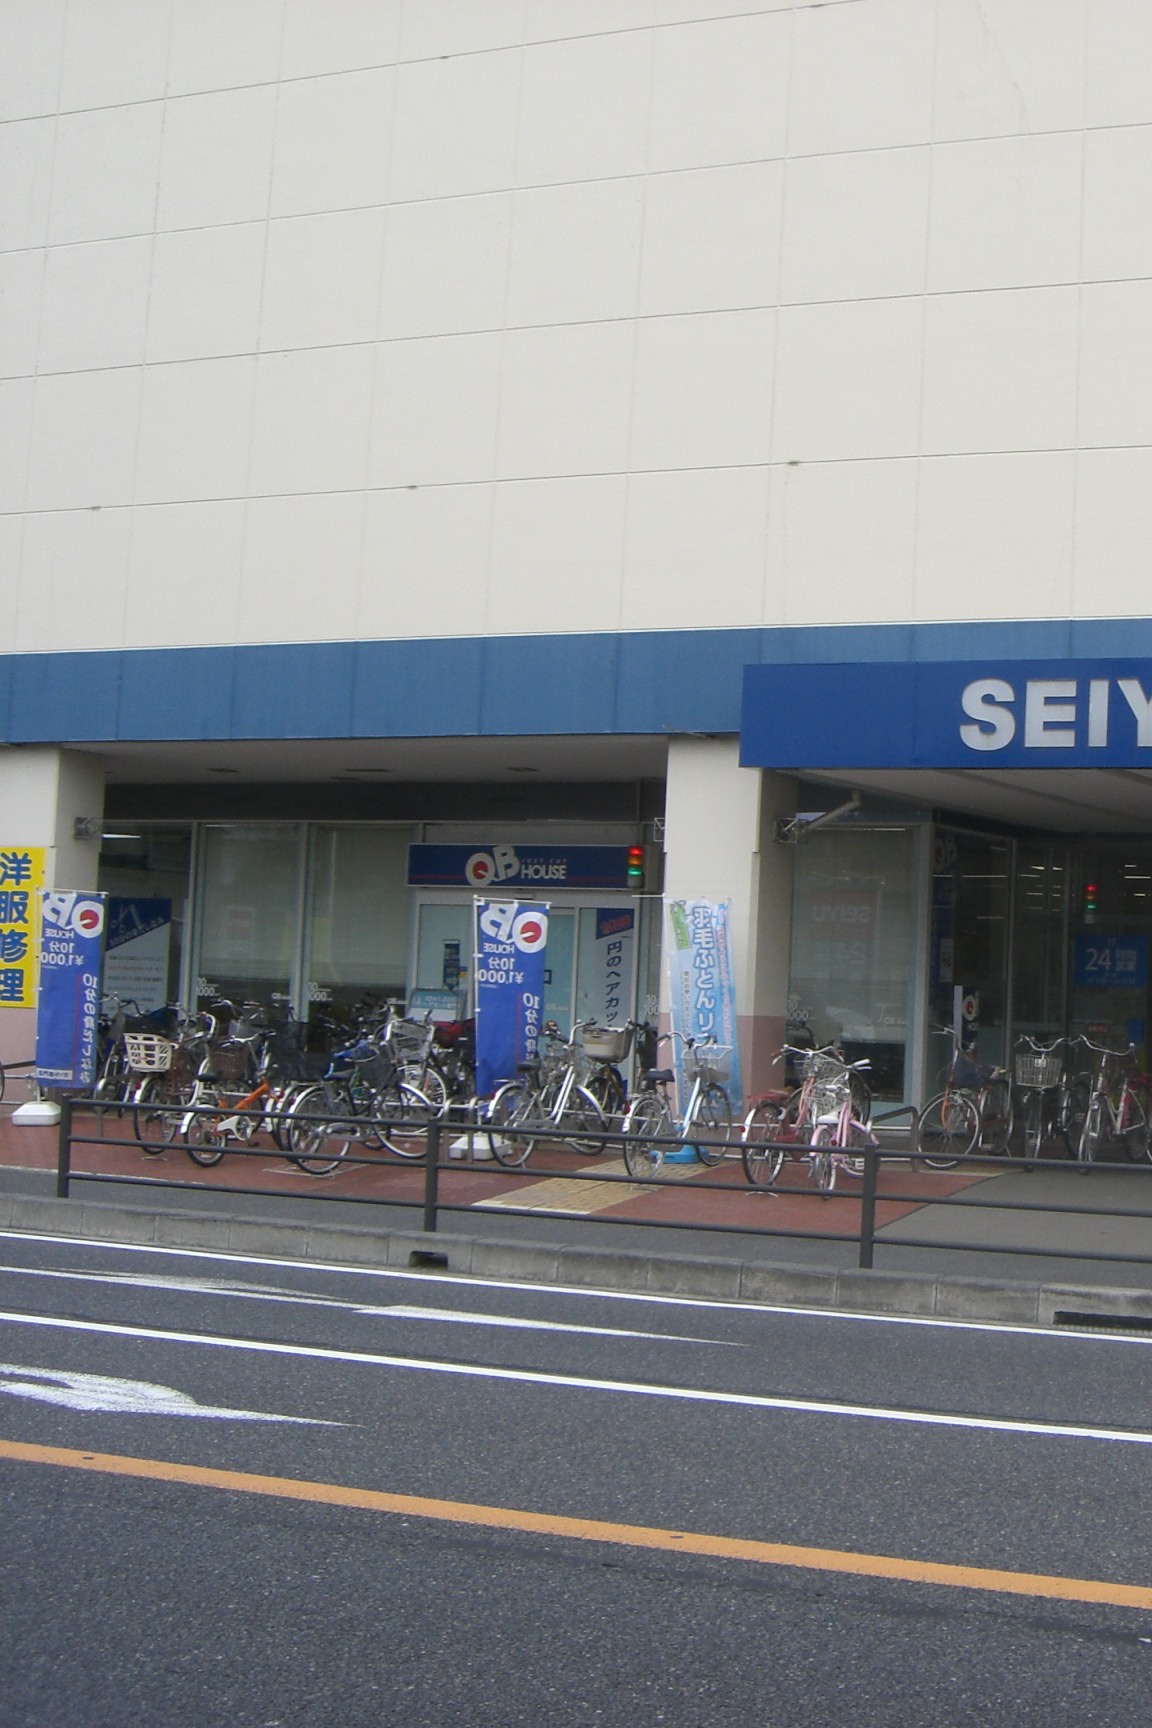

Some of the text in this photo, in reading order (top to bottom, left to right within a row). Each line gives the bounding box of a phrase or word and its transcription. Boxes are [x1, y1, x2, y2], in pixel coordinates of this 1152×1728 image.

[465, 846, 520, 887] QB
[521, 864, 567, 879] HOUSE
[0, 852, 32, 1003] 洋服修理
[1085, 948, 1112, 971] 24
[605, 940, 622, 1027] 円のヘアカッ
